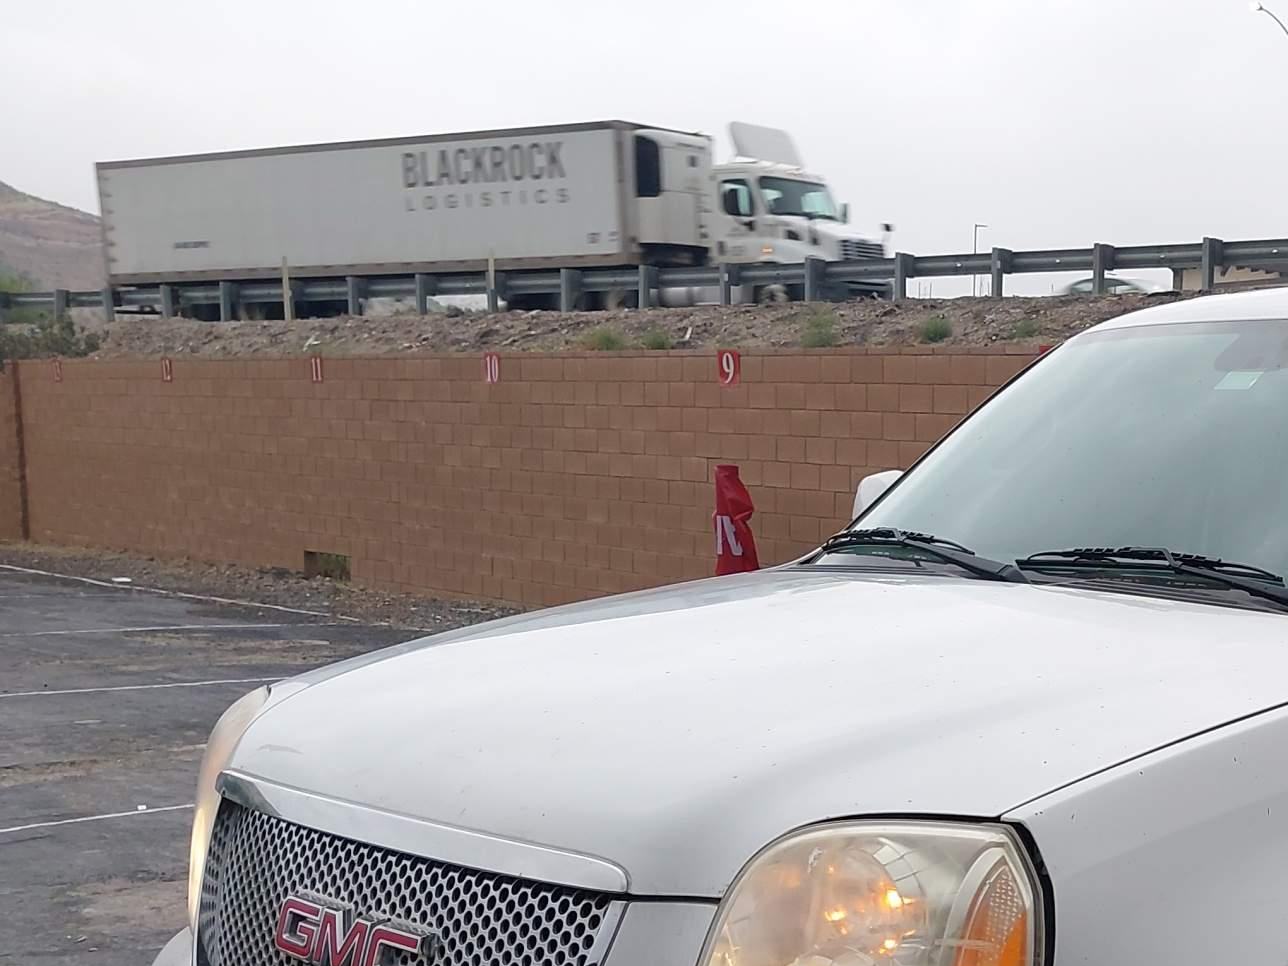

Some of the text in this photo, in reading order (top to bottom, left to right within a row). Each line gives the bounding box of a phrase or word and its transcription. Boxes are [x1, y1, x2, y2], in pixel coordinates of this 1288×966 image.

[402, 141, 567, 188] BLACKROCK
[404, 188, 571, 212] LOGISTICS
[311, 357, 323, 381] 11
[485, 355, 499, 383] 10
[722, 352, 734, 384] 9
